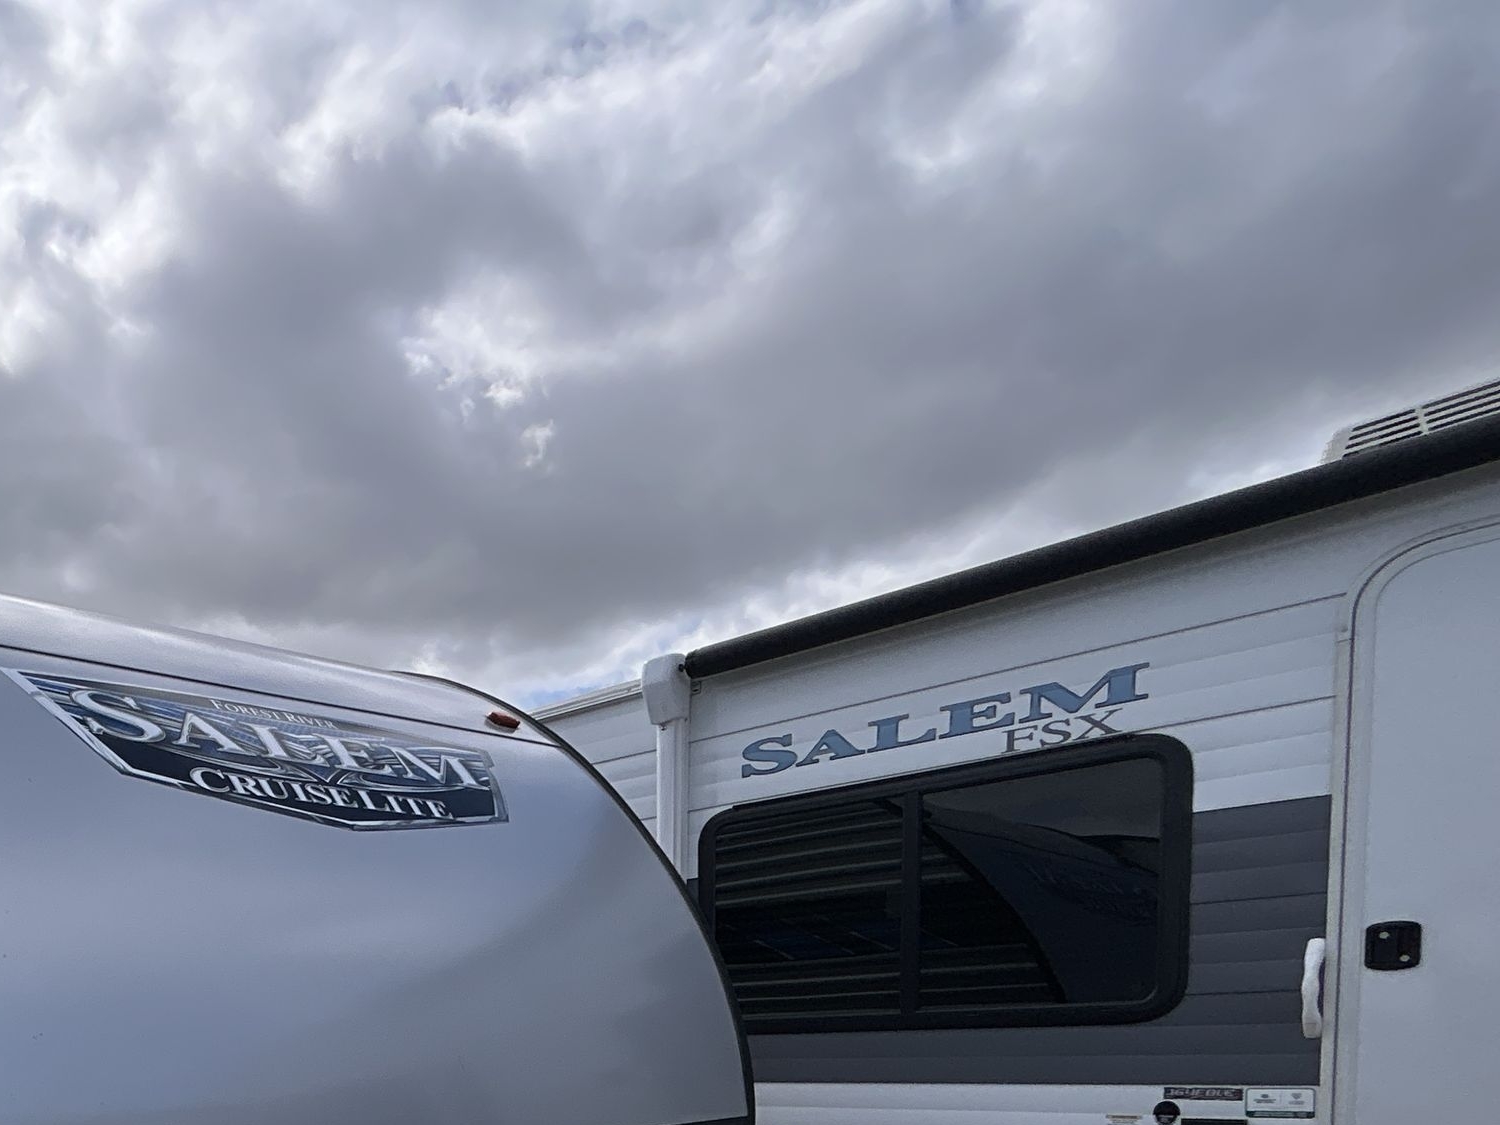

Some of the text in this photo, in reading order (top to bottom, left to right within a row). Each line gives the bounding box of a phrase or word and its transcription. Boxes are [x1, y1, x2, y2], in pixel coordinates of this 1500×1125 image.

[70, 687, 492, 792] SALEM
[209, 698, 339, 730] FOREST RIVER
[741, 662, 1151, 779] SALEM
[1002, 708, 1123, 754] FSX
